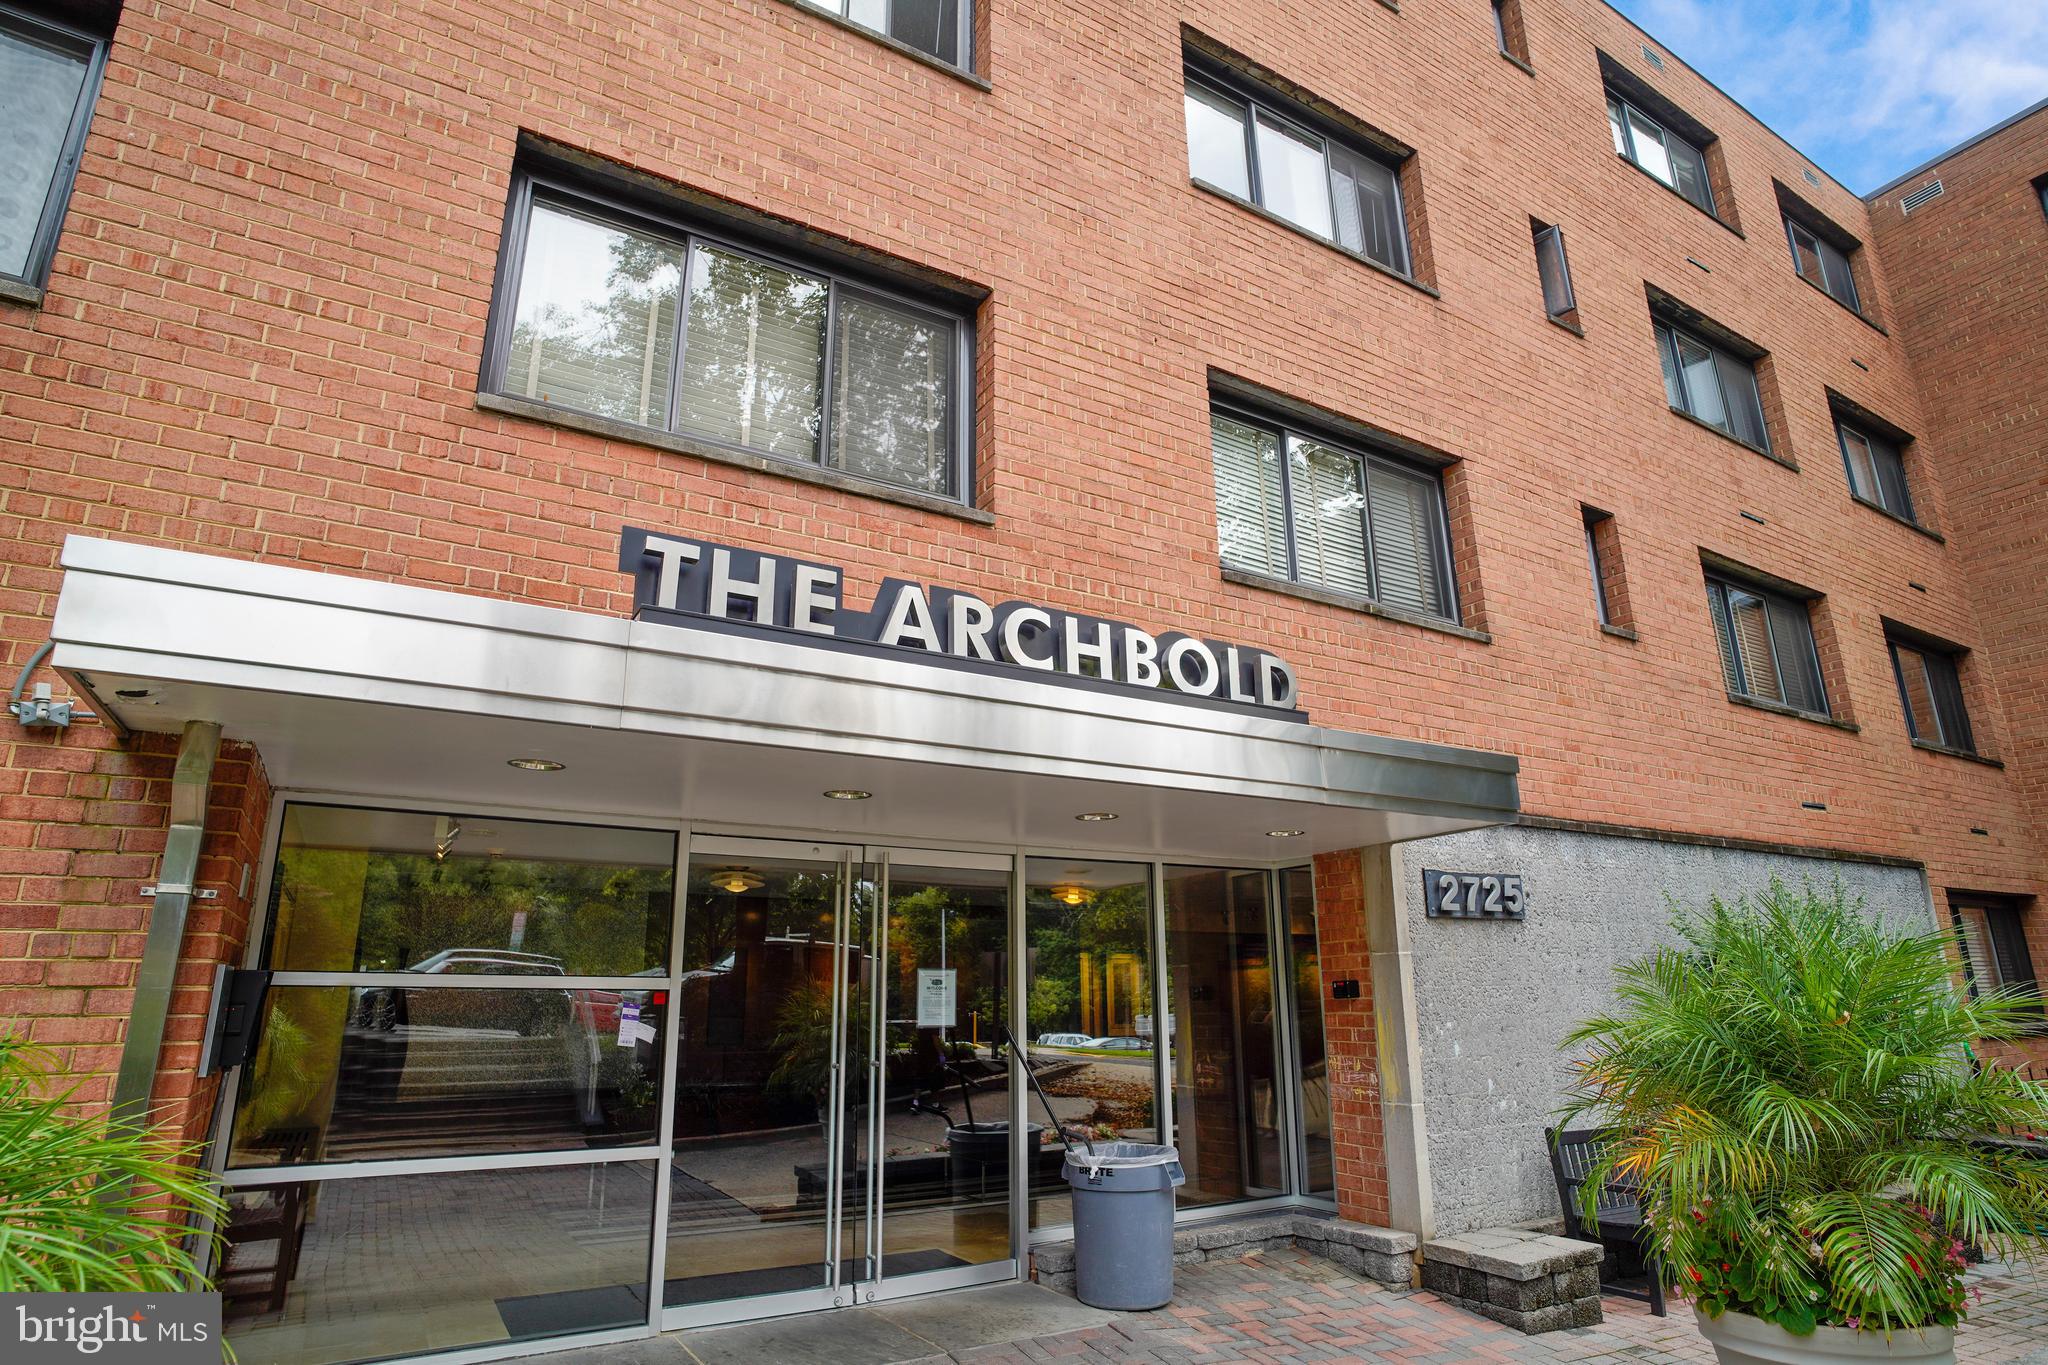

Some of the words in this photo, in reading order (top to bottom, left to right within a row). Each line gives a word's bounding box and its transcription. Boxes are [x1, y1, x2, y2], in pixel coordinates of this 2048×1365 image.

[643, 535, 837, 635] THE
[878, 585, 1298, 710] ARCHBOLD
[1440, 874, 1524, 913] 2725
